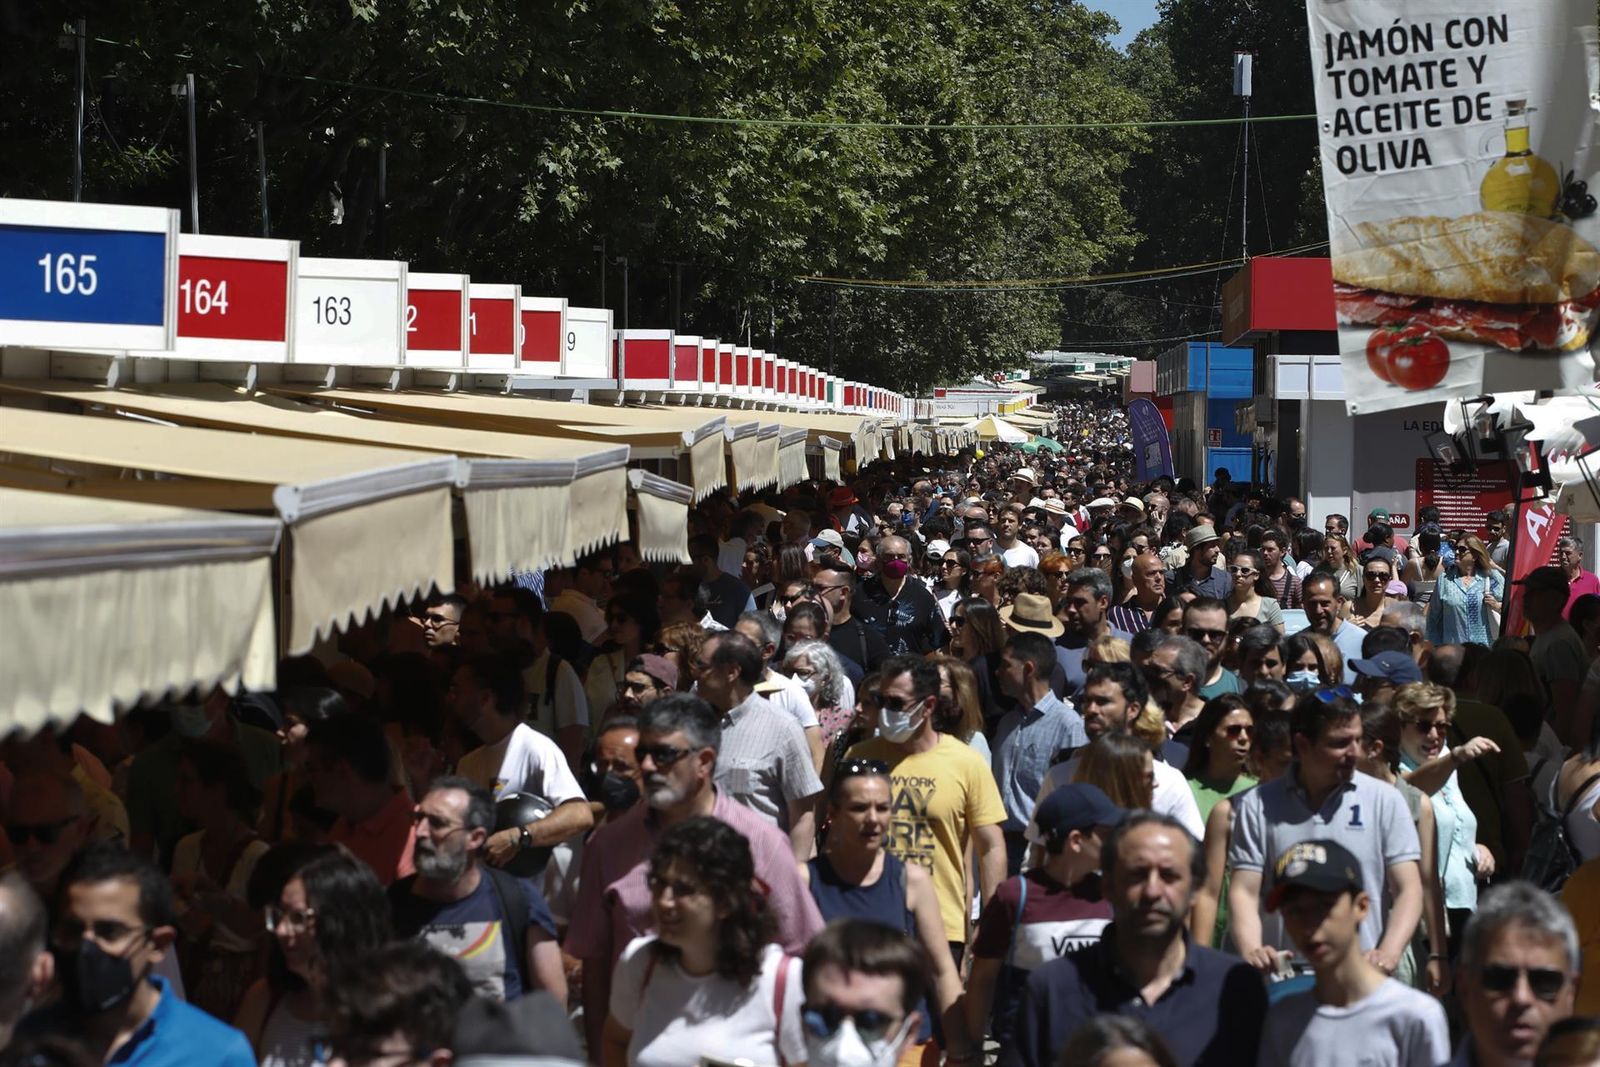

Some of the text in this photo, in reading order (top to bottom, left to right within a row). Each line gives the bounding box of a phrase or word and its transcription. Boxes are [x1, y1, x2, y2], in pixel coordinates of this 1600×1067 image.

[1325, 14, 1509, 69] JAMÓN CON
[1327, 54, 1487, 100] TOMATE Y
[1333, 92, 1492, 138] ACEITE DE
[1336, 137, 1433, 175] OLIVA
[38, 253, 98, 295] 165
[180, 278, 229, 315] 164
[313, 296, 352, 325] 163
[1403, 420, 1419, 431] LA
[1348, 804, 1363, 826] 1
